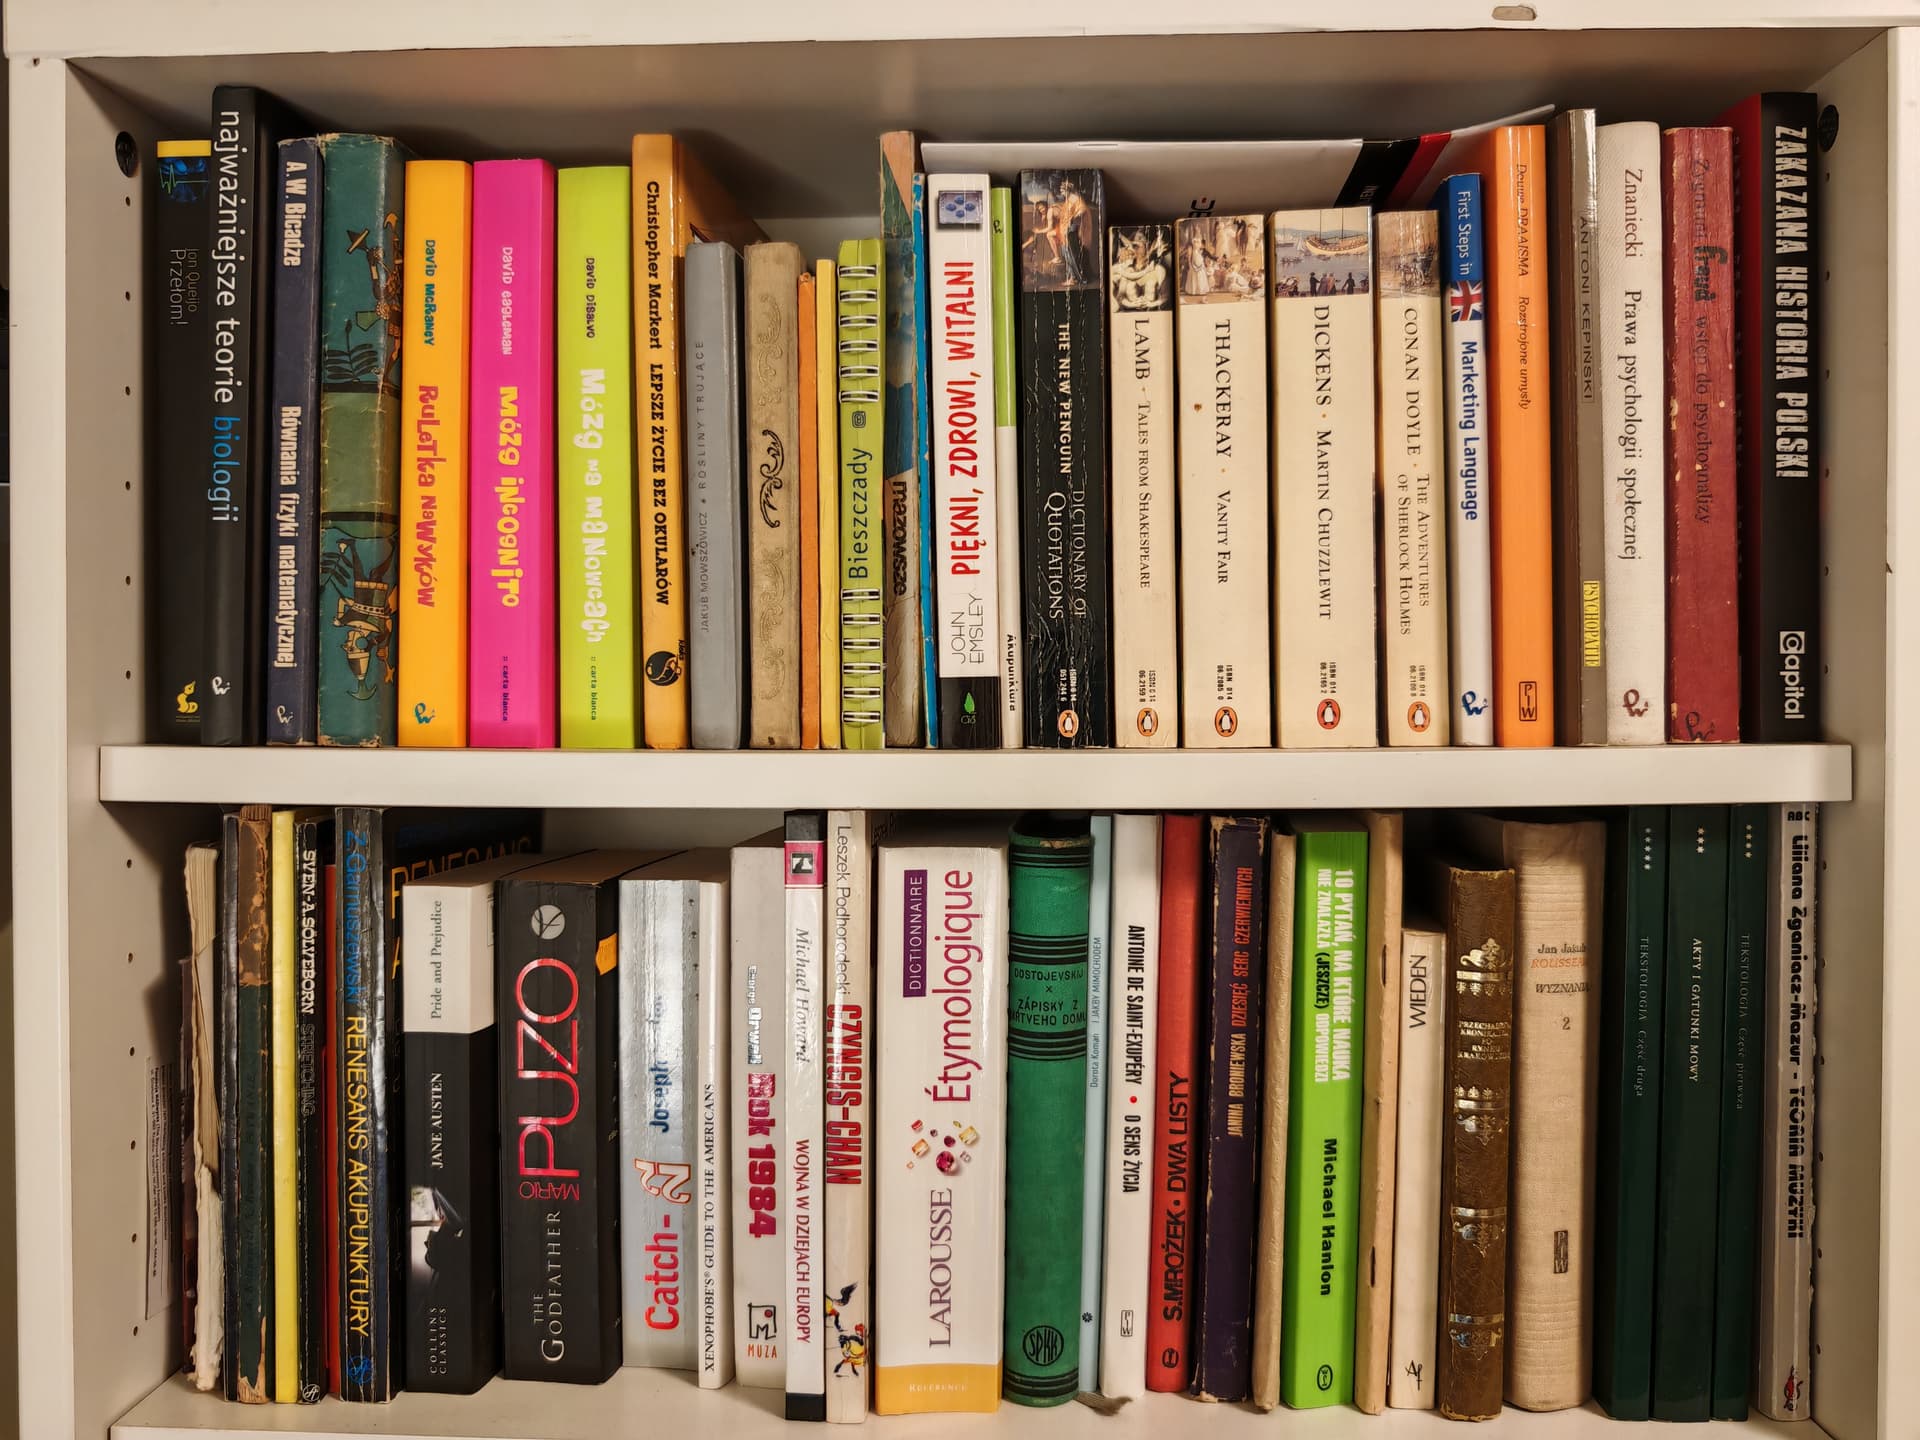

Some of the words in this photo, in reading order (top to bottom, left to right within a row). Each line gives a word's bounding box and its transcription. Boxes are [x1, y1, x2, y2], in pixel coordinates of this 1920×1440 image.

[211, 110, 247, 306] najważniejsze
[1457, 191, 1471, 220] First
[1624, 168, 1644, 258] Znaniecki
[1775, 126, 1808, 254] ZAKAZANA
[283, 202, 306, 266] Bicadze
[646, 181, 660, 278] Christopher
[1456, 224, 1472, 258] Steps
[1516, 207, 1530, 278] DRAAISMA
[1580, 216, 1591, 294] ANTONI
[170, 250, 188, 325] Przełom!
[184, 271, 200, 312] Queijo
[1460, 263, 1472, 275] in
[648, 284, 662, 350] Markert
[944, 262, 978, 361] WITALNI
[1058, 324, 1070, 351] THE
[1516, 296, 1530, 365] Rozstrojone
[1624, 290, 1642, 345] Prawa
[1693, 316, 1708, 366] wstęp
[1775, 266, 1808, 380] HISTORIA
[214, 318, 242, 403] teorie
[1058, 358, 1070, 394] NEW
[1134, 319, 1150, 380] LAMB
[1314, 305, 1332, 406] DICKENS
[1404, 308, 1420, 382] CONAN
[1580, 303, 1593, 400] KĘPIŃSKI
[650, 363, 664, 420] LEPSZE
[1214, 319, 1232, 458] THACKERAY
[1459, 340, 1480, 430] Marketing
[1518, 368, 1532, 410] umysły
[1617, 355, 1642, 459] psychologii
[1696, 373, 1712, 394] do
[280, 406, 302, 485] Równania
[652, 426, 668, 473] ŻYCIE
[946, 372, 982, 478] ZDROWI,
[1059, 402, 1072, 474] PENGUIN
[1406, 391, 1421, 456] DOYLE
[1775, 392, 1808, 478] POLSKI
[208, 416, 240, 522] biologii
[696, 422, 708, 490] ROŚLINY
[1461, 436, 1480, 521] Language
[1692, 402, 1712, 524] psychoanalizy
[276, 492, 300, 537] fizyki
[652, 478, 666, 508] BEZ
[848, 448, 872, 579] Bieszczady
[1617, 468, 1642, 561] społecznej
[654, 512, 672, 605] OKULARÓW
[892, 481, 908, 596] mazowsze
[948, 488, 988, 575] PIĘKNI,
[1070, 490, 1086, 592] DICTIONARY
[273, 544, 298, 668] matematycznej
[700, 596, 711, 633] JAKUB
[950, 612, 966, 664] JOHN
[968, 592, 984, 664] EMSLEY
[1073, 598, 1086, 619] OF
[1584, 582, 1600, 666] PSYCHOPATIE
[836, 825, 852, 882] Leszek
[1317, 868, 1332, 886] NIE
[1335, 869, 1353, 888] 10
[430, 900, 444, 956] Prejudice
[908, 876, 923, 990] DICTIONNAIRE
[1234, 867, 1253, 944] CZERWIENNYCH
[1316, 890, 1331, 948] ZNALAZŁA
[1332, 893, 1356, 946] PYTAŃ,
[431, 962, 443, 983] and
[794, 928, 810, 992] Michael
[835, 886, 852, 995] Podhorodecki
[1127, 925, 1145, 973] ANTOINE
[1232, 951, 1248, 976] SERC
[1334, 950, 1353, 973] NA
[1537, 944, 1557, 954] Jan
[1692, 938, 1702, 970] AKTY
[430, 989, 443, 1019] Pride
[924, 870, 983, 1102] Étymologique
[1018, 996, 1063, 1012] ZÁPISKY
[1072, 1000, 1078, 1010] Z
[1127, 977, 1144, 991] DE
[1229, 983, 1251, 1027] DZIESIĘĆ
[1314, 952, 1330, 1009] (JESZCZE)
[1333, 977, 1356, 1023] KTÓRE
[1408, 955, 1426, 1029] WIEDEŃ
[1638, 936, 1649, 1020] TEKSTOLOGIA
[1739, 933, 1750, 1018] TEKSTOLOGIA
[794, 997, 810, 1063] Howard
[1125, 995, 1146, 1085] SAINT-EXUPÉRY
[1562, 1017, 1570, 1030] 2
[1690, 984, 1701, 1039] GATUNKI
[300, 1024, 316, 1116] STRETCHING
[515, 958, 580, 1178] PUZO
[1228, 1033, 1246, 1097] BRONIEWSKA
[1314, 1013, 1329, 1083] ODPOWIEDZI
[1332, 1028, 1351, 1080] NAUKA
[1689, 1044, 1699, 1082] MOWY
[346, 1016, 368, 1150] RENESANS
[430, 1072, 443, 1129] AUSTEN
[747, 1073, 776, 1137] Rok
[826, 1005, 862, 1185] CZYNGIS-CHAN
[1168, 1071, 1189, 1134] LISTY
[1634, 1065, 1647, 1097] druga
[431, 1133, 443, 1168] JANE
[703, 1084, 715, 1165] AMERICANS
[1124, 1126, 1140, 1156] SENS
[1227, 1104, 1244, 1137] JANINA
[519, 1182, 580, 1201] MARIO
[704, 1169, 714, 1198] THE
[748, 1144, 777, 1238] 1984
[793, 1139, 810, 1192] WOJNA
[1122, 1160, 1143, 1193] ŻYCIA
[1168, 1140, 1188, 1193] DWA
[1322, 1138, 1337, 1218] Michael
[704, 1202, 714, 1222] TO
[796, 1195, 810, 1210] W
[348, 1158, 370, 1336] AKUPUNKTURY
[704, 1225, 715, 1268] GUIDE
[793, 1214, 810, 1282] DZIEJACH
[929, 1188, 952, 1348] LAROUSSE
[1320, 1225, 1335, 1296] Hanlon
[533, 1293, 543, 1326] THE
[540, 1211, 565, 1362] GODFATHER
[796, 1286, 810, 1344] EUROPY
[430, 1308, 438, 1375] COLLINS
[439, 1308, 447, 1375] CLASSICS
[748, 1344, 778, 1358] MUZA
